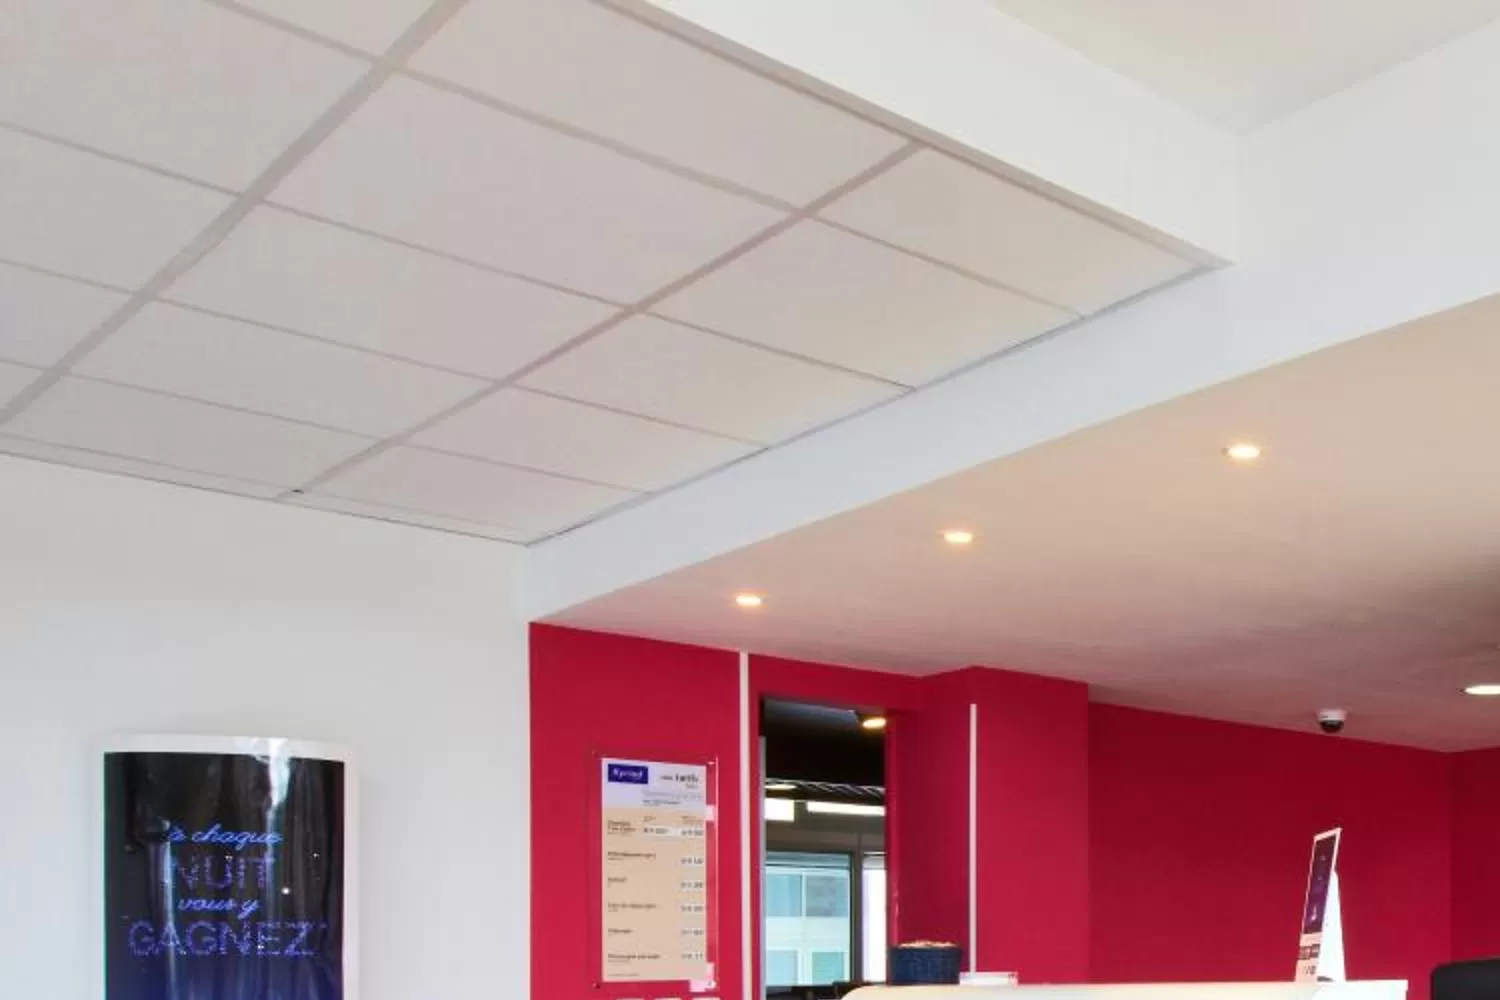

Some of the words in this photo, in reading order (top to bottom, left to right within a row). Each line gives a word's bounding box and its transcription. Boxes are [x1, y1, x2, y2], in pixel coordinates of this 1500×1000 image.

[192, 823, 284, 850] chaque
[177, 898, 234, 911] vous
[237, 899, 259, 919] y
